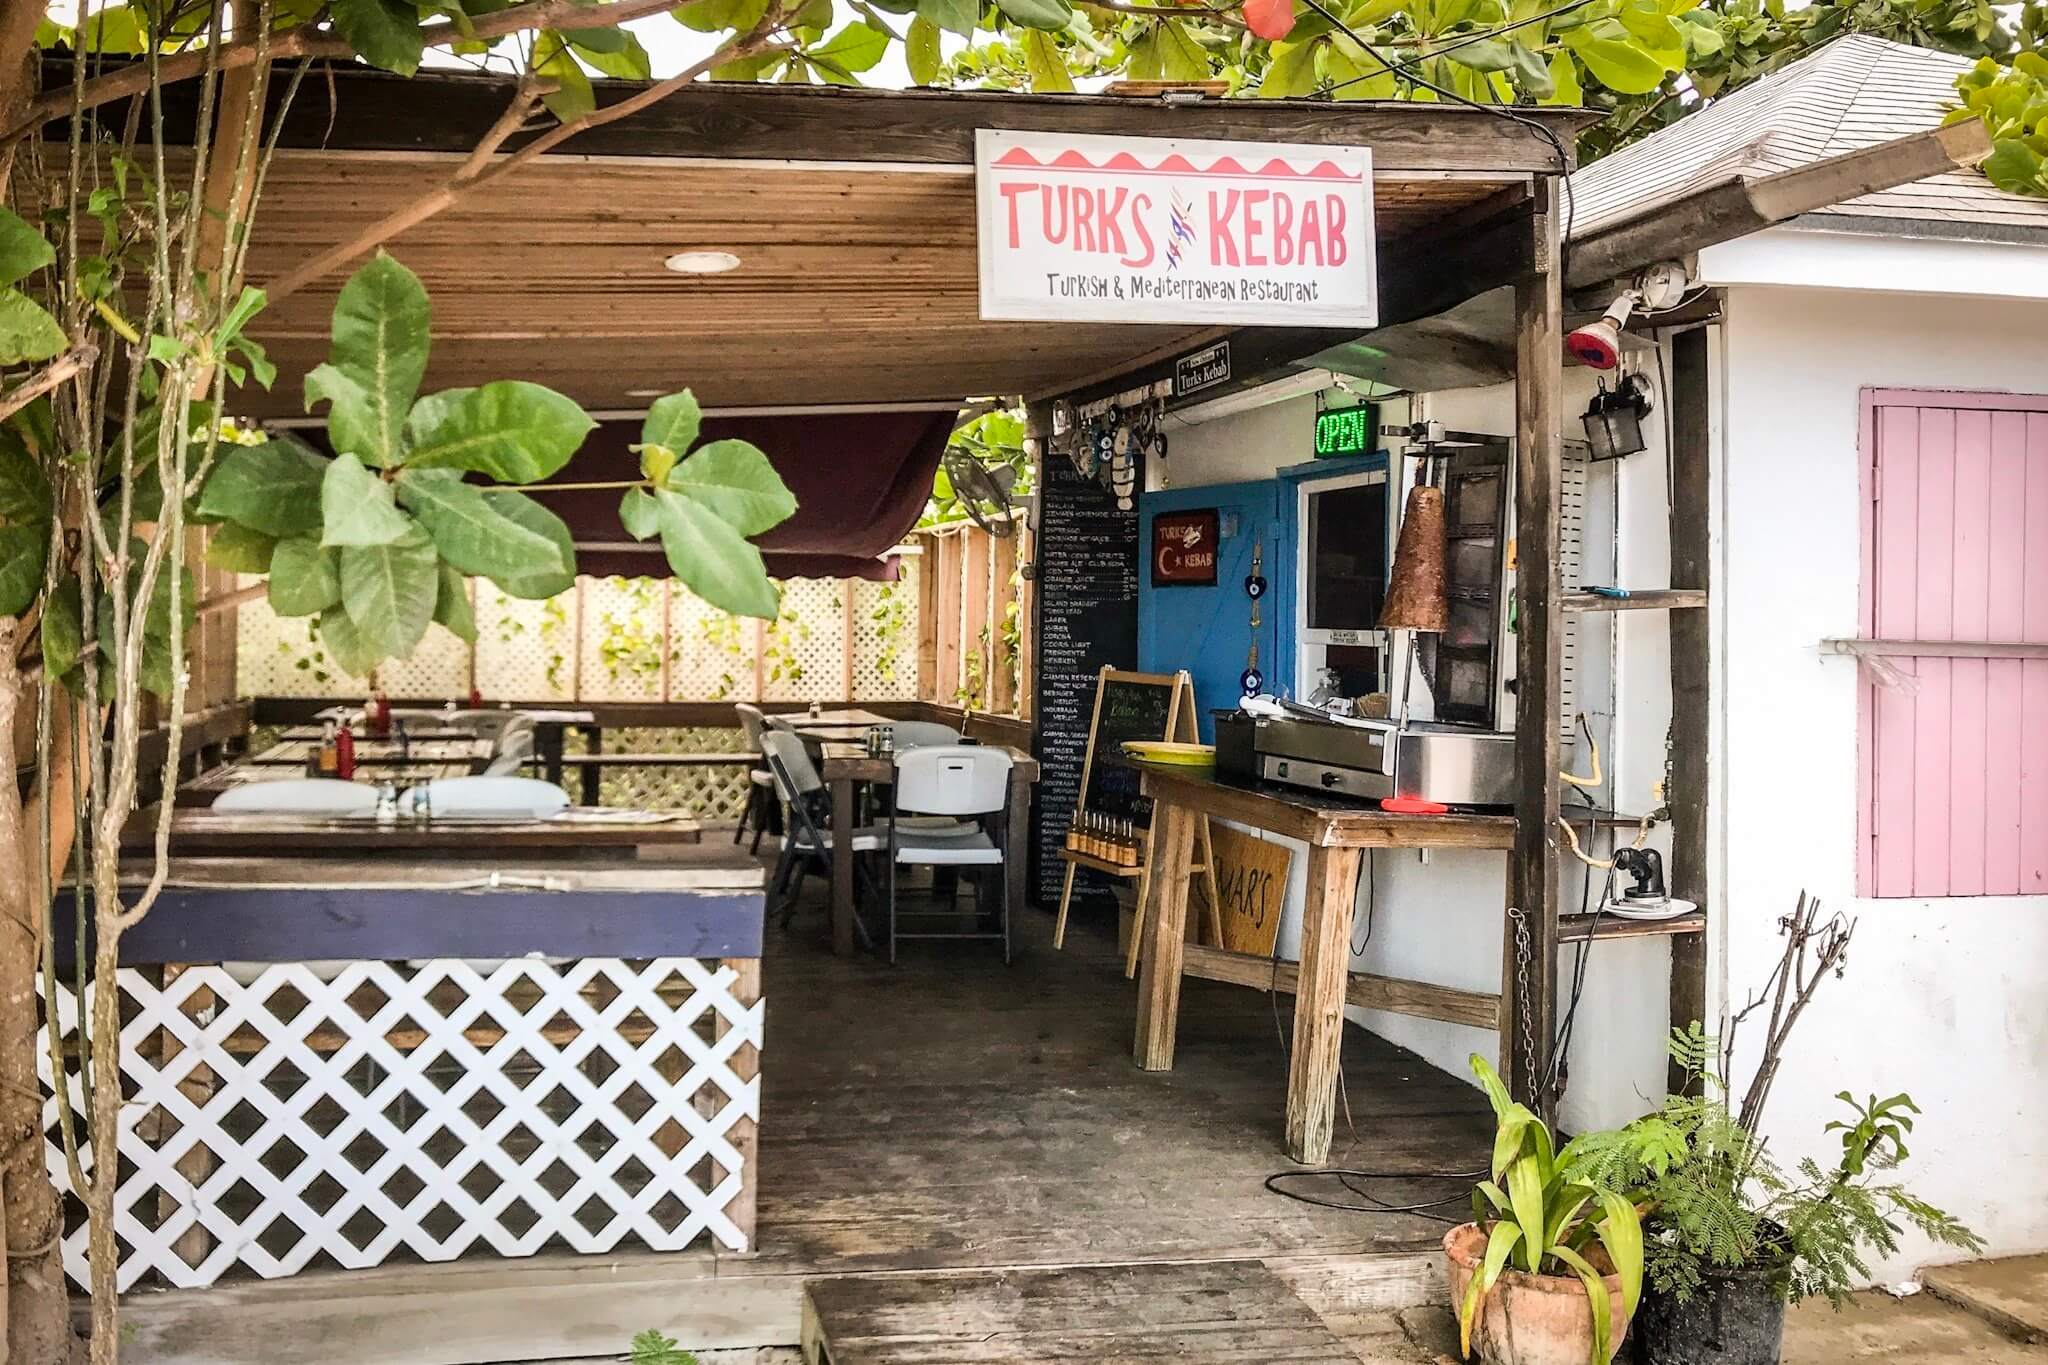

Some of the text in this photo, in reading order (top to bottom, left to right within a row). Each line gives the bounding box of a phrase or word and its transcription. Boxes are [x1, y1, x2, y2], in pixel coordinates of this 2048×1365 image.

[1000, 182, 1347, 268] TURKS KEBAB
[1113, 275, 1124, 299] &
[1180, 370, 1202, 390] Turks
[1203, 359, 1227, 382] Kebab
[1316, 410, 1366, 453] OPEN
[1185, 552, 1213, 568] KEBAB
